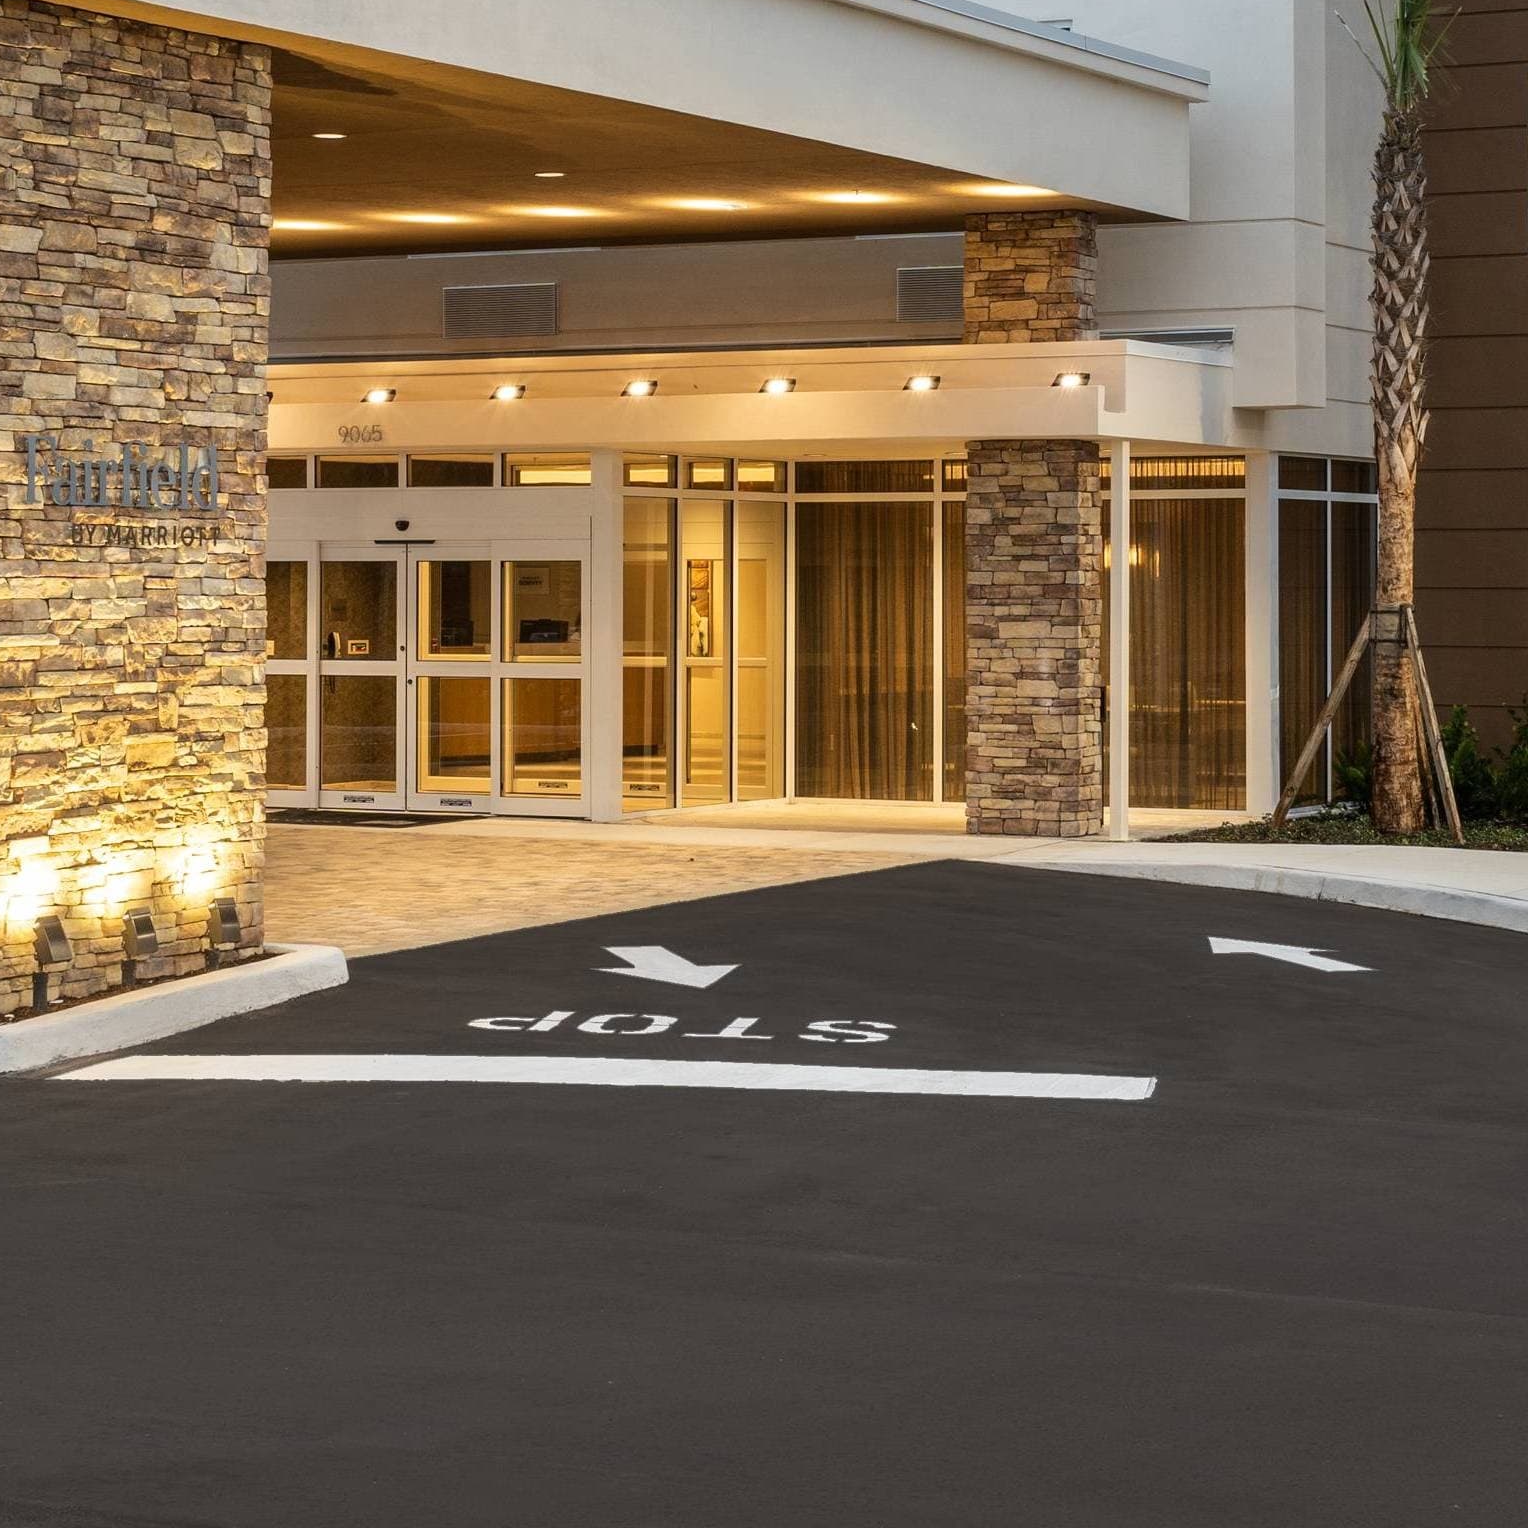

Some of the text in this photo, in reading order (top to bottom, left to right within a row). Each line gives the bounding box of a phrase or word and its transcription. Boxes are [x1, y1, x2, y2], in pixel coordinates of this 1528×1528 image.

[338, 424, 383, 443] 9065
[25, 435, 219, 511] Fairfield
[72, 524, 220, 546] BY MARRIOTT
[467, 1010, 898, 1043] STOP
